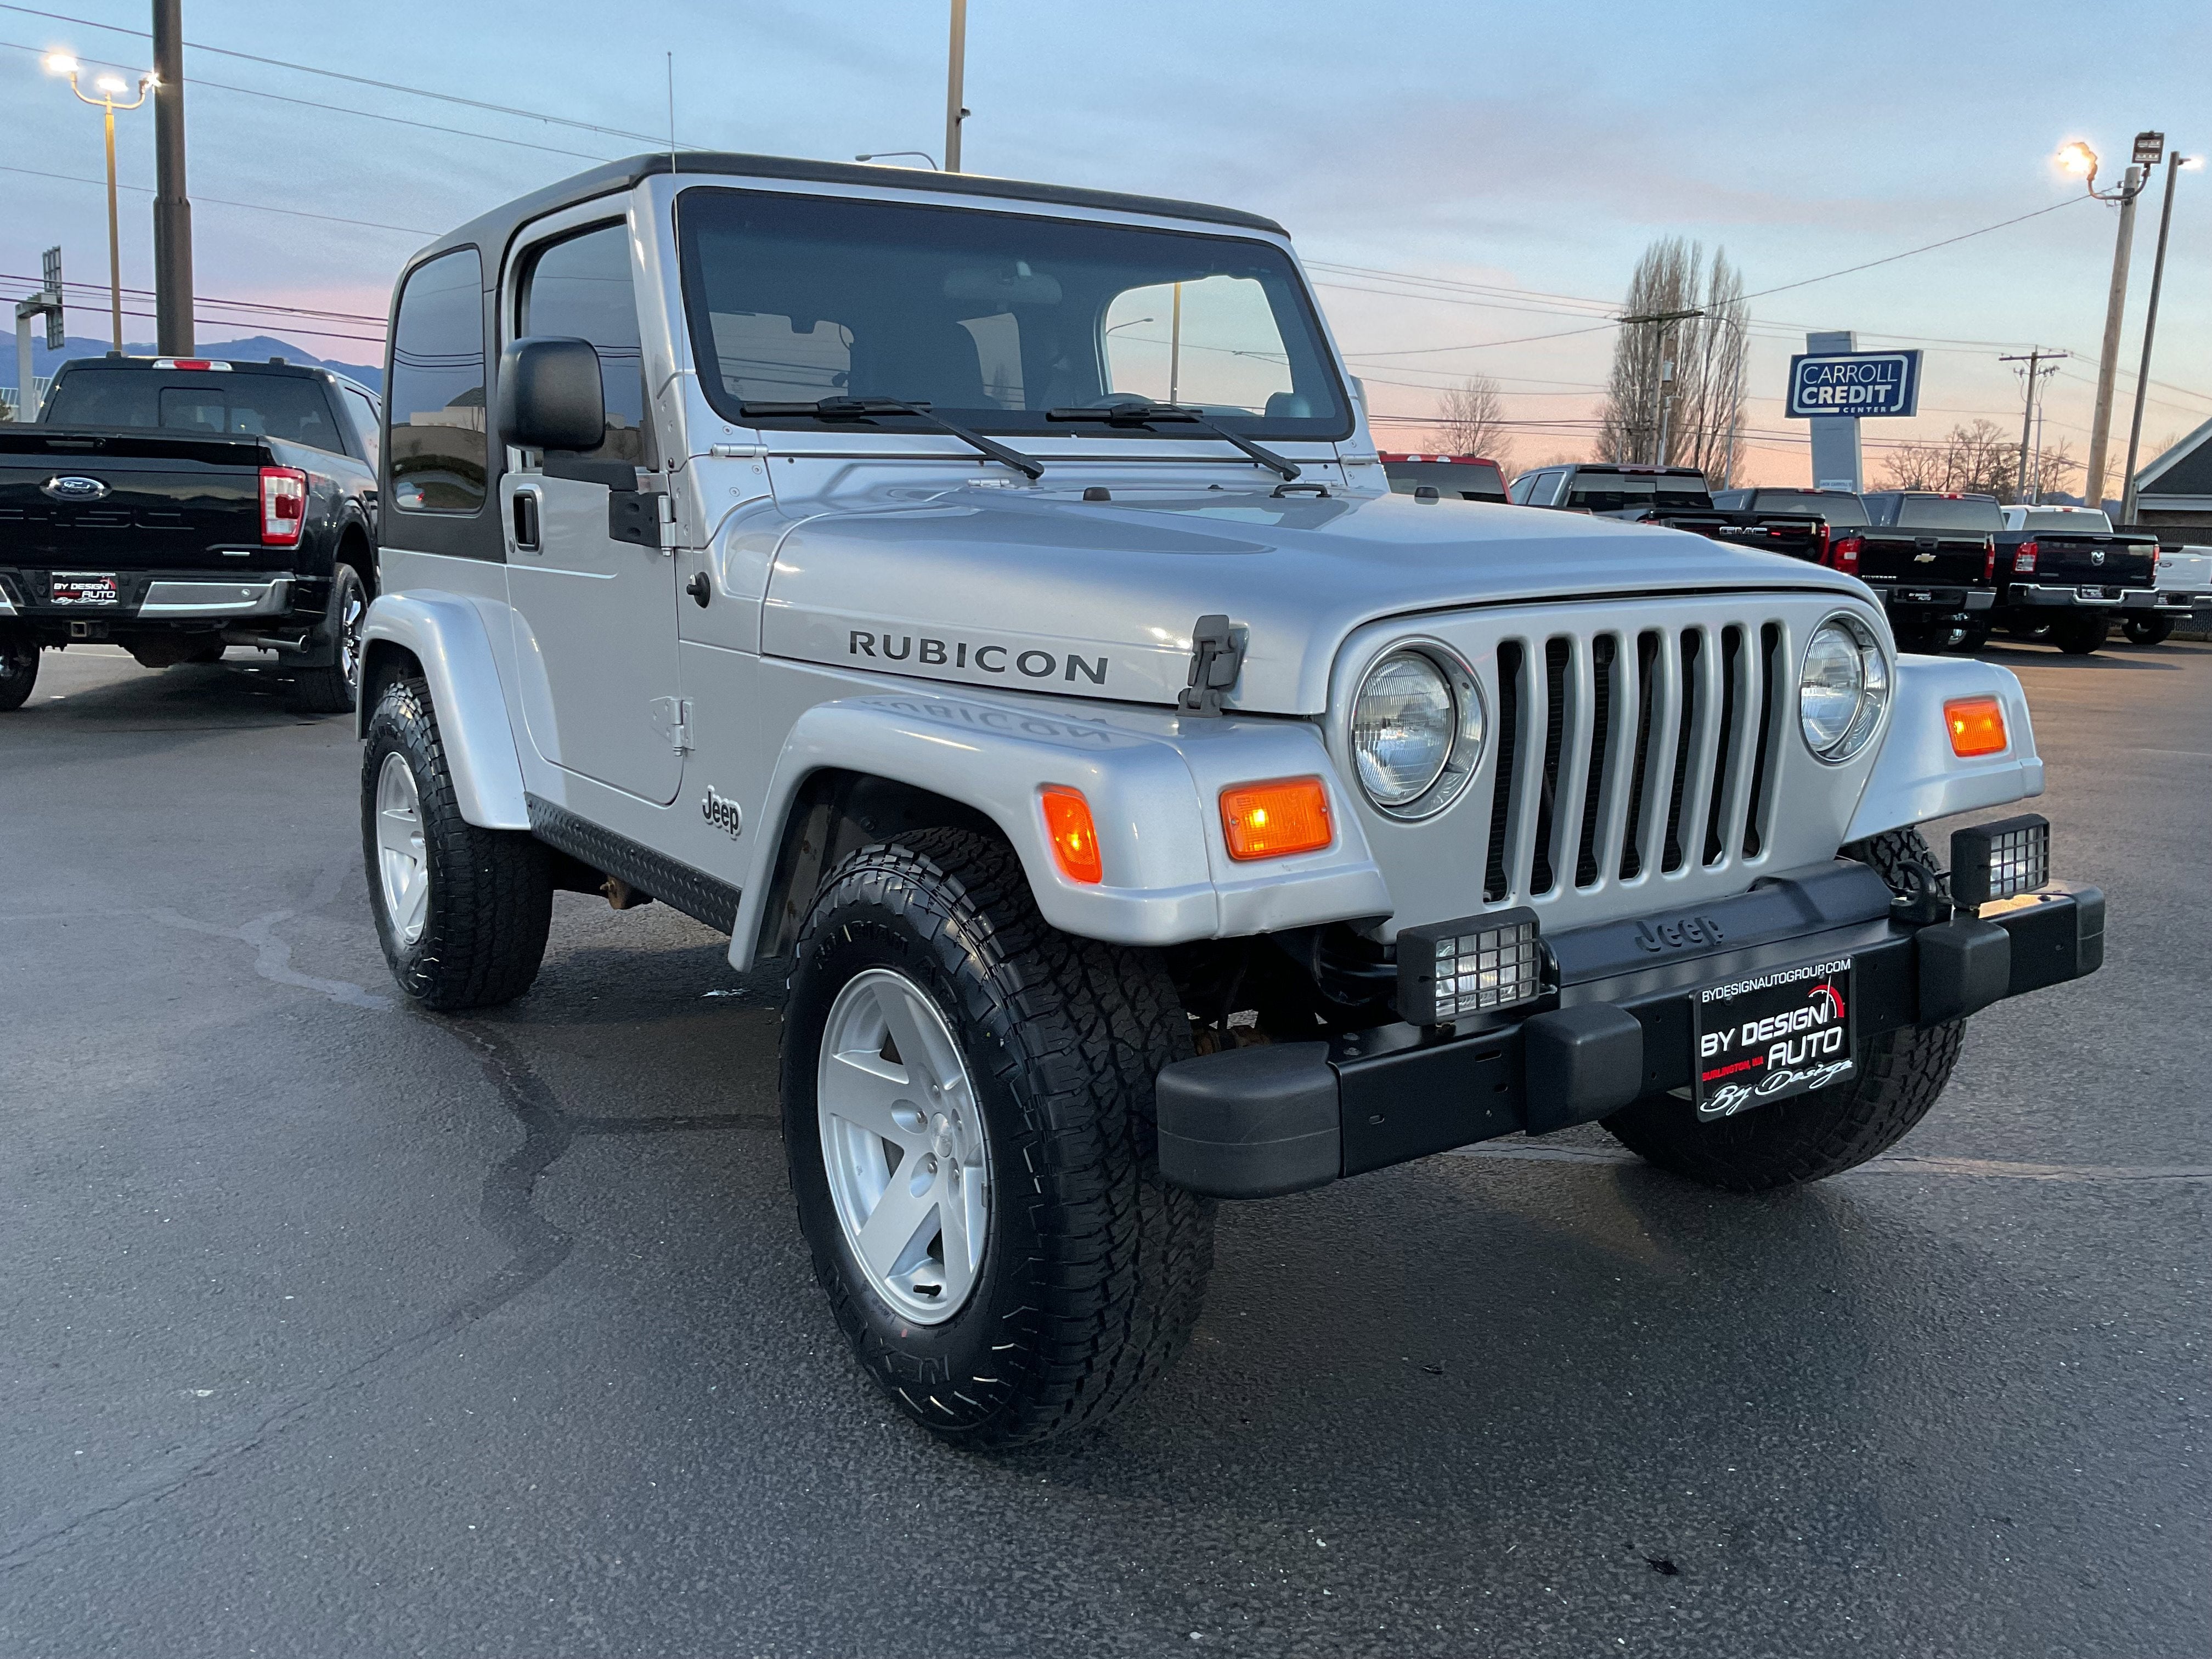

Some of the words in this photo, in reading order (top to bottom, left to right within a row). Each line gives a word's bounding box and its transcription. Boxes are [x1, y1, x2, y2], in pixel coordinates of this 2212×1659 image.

[1802, 385, 1892, 405] CREDIT
[1803, 364, 1898, 385] CARROLL
[1719, 526, 1768, 536] GMC
[850, 630, 1108, 685] RUBICON
[702, 789, 739, 835] Jeep
[1635, 916, 1724, 952] Jeep
[1702, 958, 1851, 1003] BYDESIGNAUTOGROUP.COM
[1701, 1028, 1735, 1057] BY
[1741, 1003, 1826, 1046] DESIGN
[1767, 1026, 1842, 1070] AUTO
[1700, 1085, 1752, 1116] By
[1755, 1059, 1853, 1095] Design
